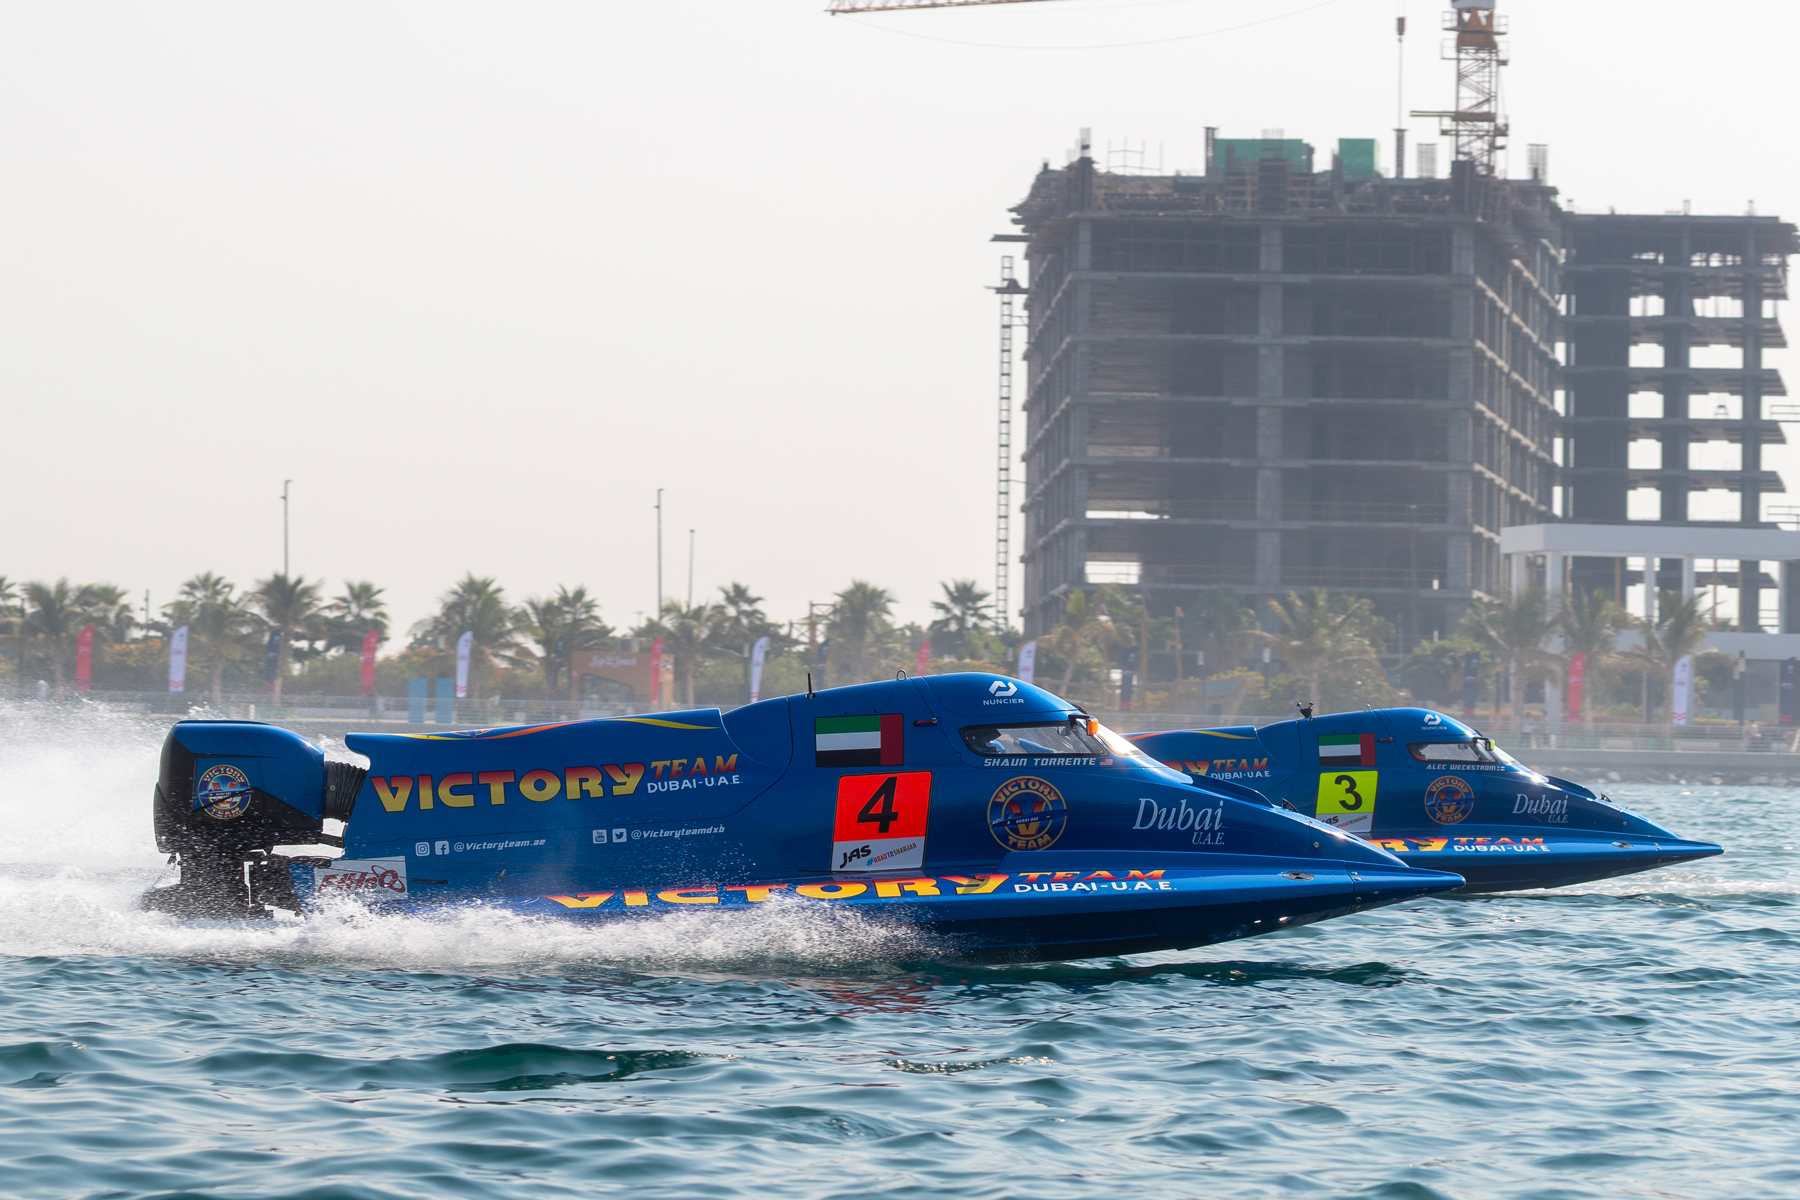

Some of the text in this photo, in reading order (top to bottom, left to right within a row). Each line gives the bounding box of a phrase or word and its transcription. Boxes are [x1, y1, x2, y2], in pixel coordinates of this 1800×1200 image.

[983, 698, 1025, 706] NUNCIER
[650, 753, 739, 780] TEAM
[984, 757, 1097, 767] SHAUN TORRENTE
[1212, 757, 1268, 772] TEAM
[202, 766, 246, 782] VICTORY
[370, 762, 646, 813] VICTORY
[646, 774, 744, 794] DUBAI-U.A.E.
[993, 778, 1060, 803] VICTORY
[1430, 777, 1470, 792] VICTORY
[1334, 774, 1363, 811] 3
[856, 776, 899, 834] 4
[1512, 793, 1569, 814] Dubai
[211, 806, 241, 818] TEAM
[1132, 798, 1224, 831] Dubai
[1322, 815, 1340, 825] AS
[1435, 812, 1464, 823] TEAM
[630, 823, 726, 840] @Victoryteamdxb
[1191, 832, 1225, 845] U.A.E.
[453, 839, 546, 853] @Victoryteam.ae
[1007, 833, 1053, 851] TEAM
[1453, 837, 1544, 845] TEAM
[840, 844, 872, 869] JAS
[866, 842, 917, 867] #ROADTOSHARJAH
[1018, 869, 1166, 883] TEAM
[544, 873, 1011, 908] VICTORY
[1013, 881, 1177, 893] DUBAI-U.A.E.
